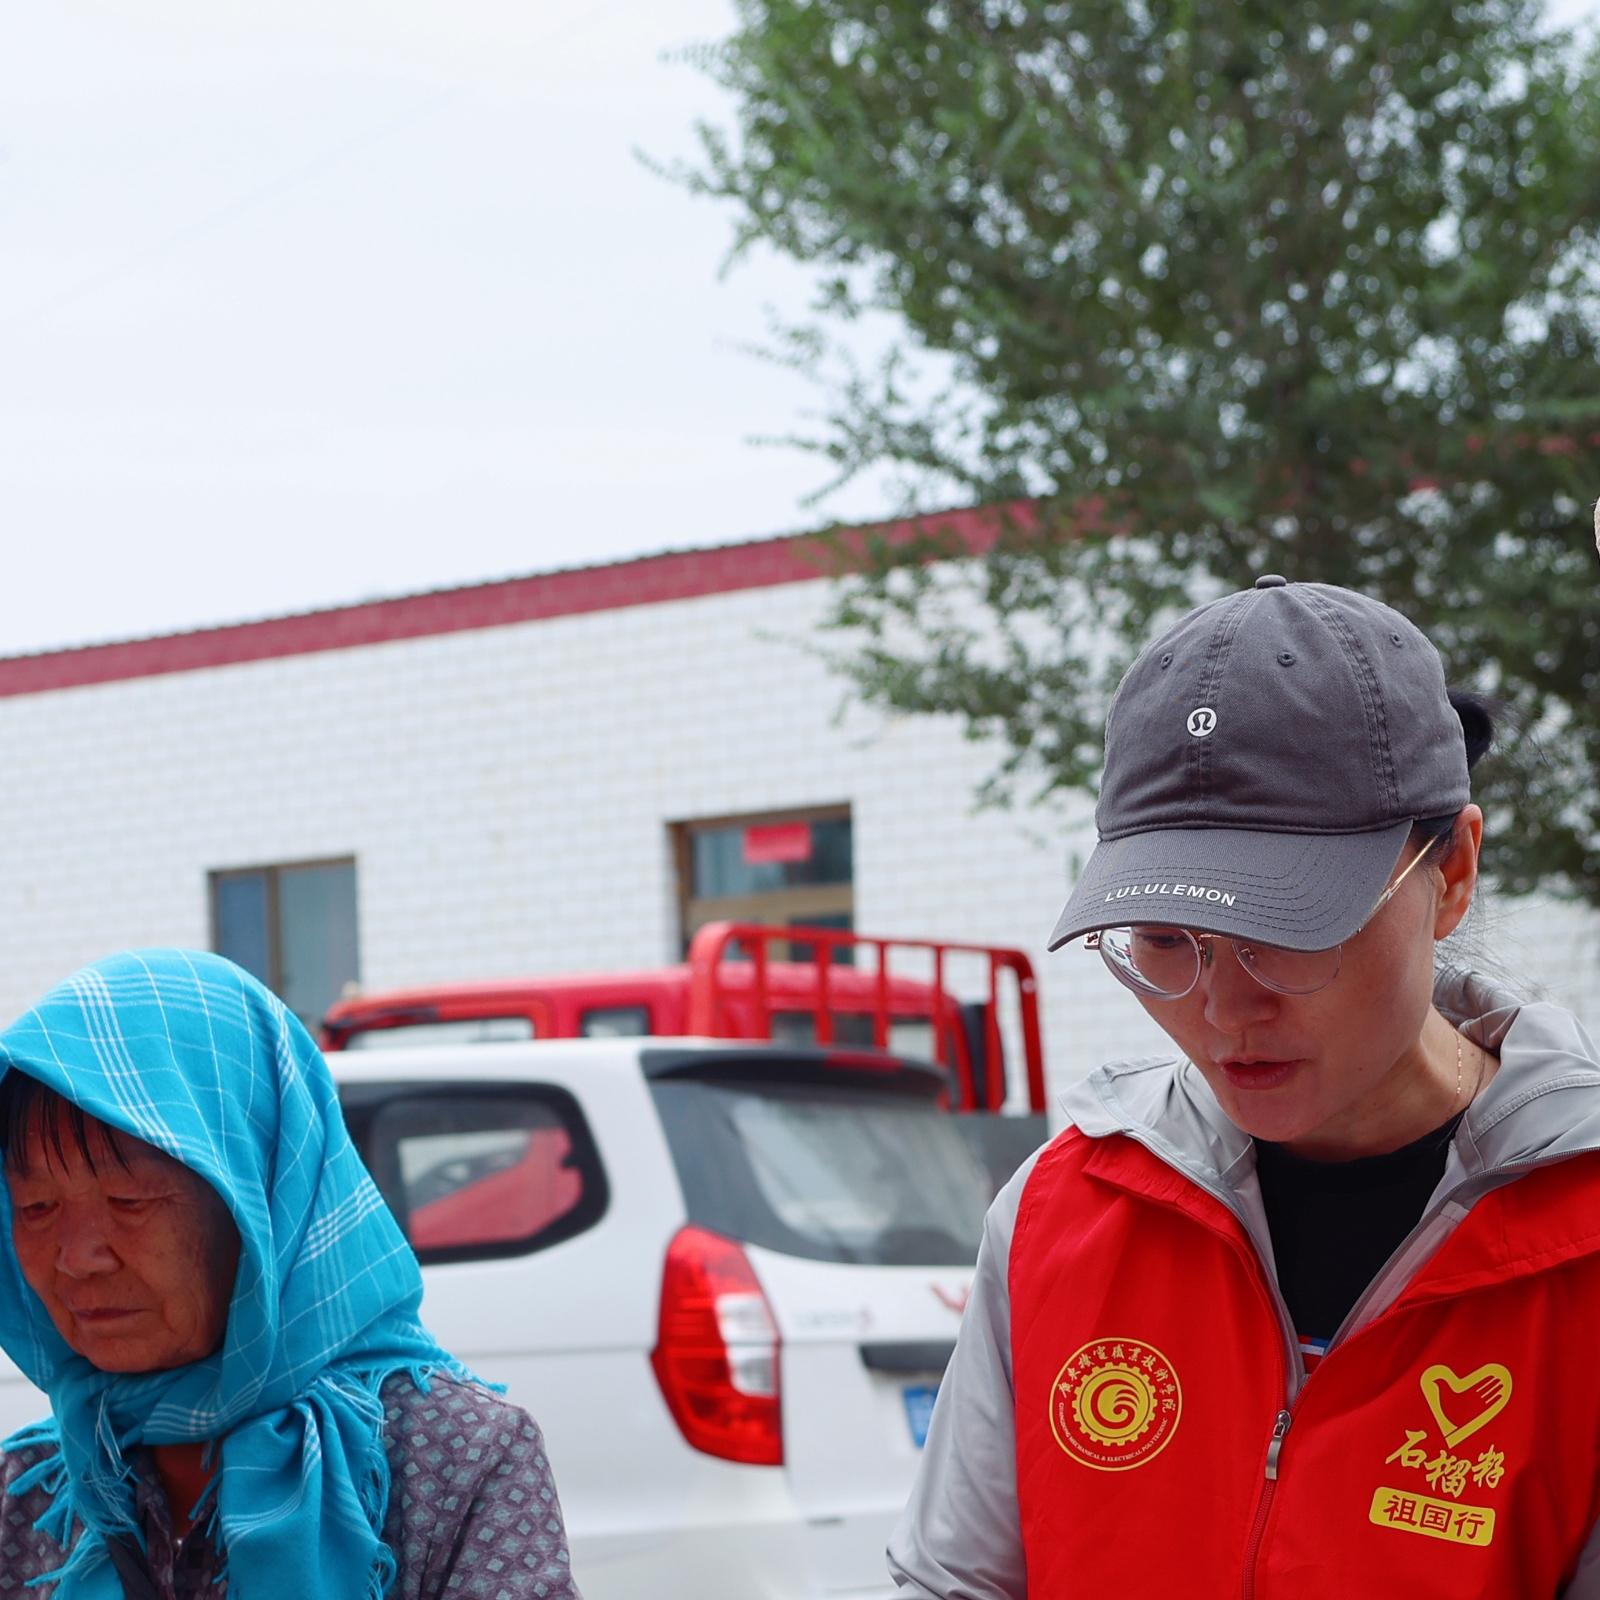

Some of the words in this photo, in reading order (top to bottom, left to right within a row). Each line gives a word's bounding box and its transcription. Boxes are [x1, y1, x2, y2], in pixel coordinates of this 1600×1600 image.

[1104, 883, 1236, 906] LULULEMON
[1385, 1429, 1505, 1498] 石榴籽
[1383, 1494, 1485, 1539] 祖国行
